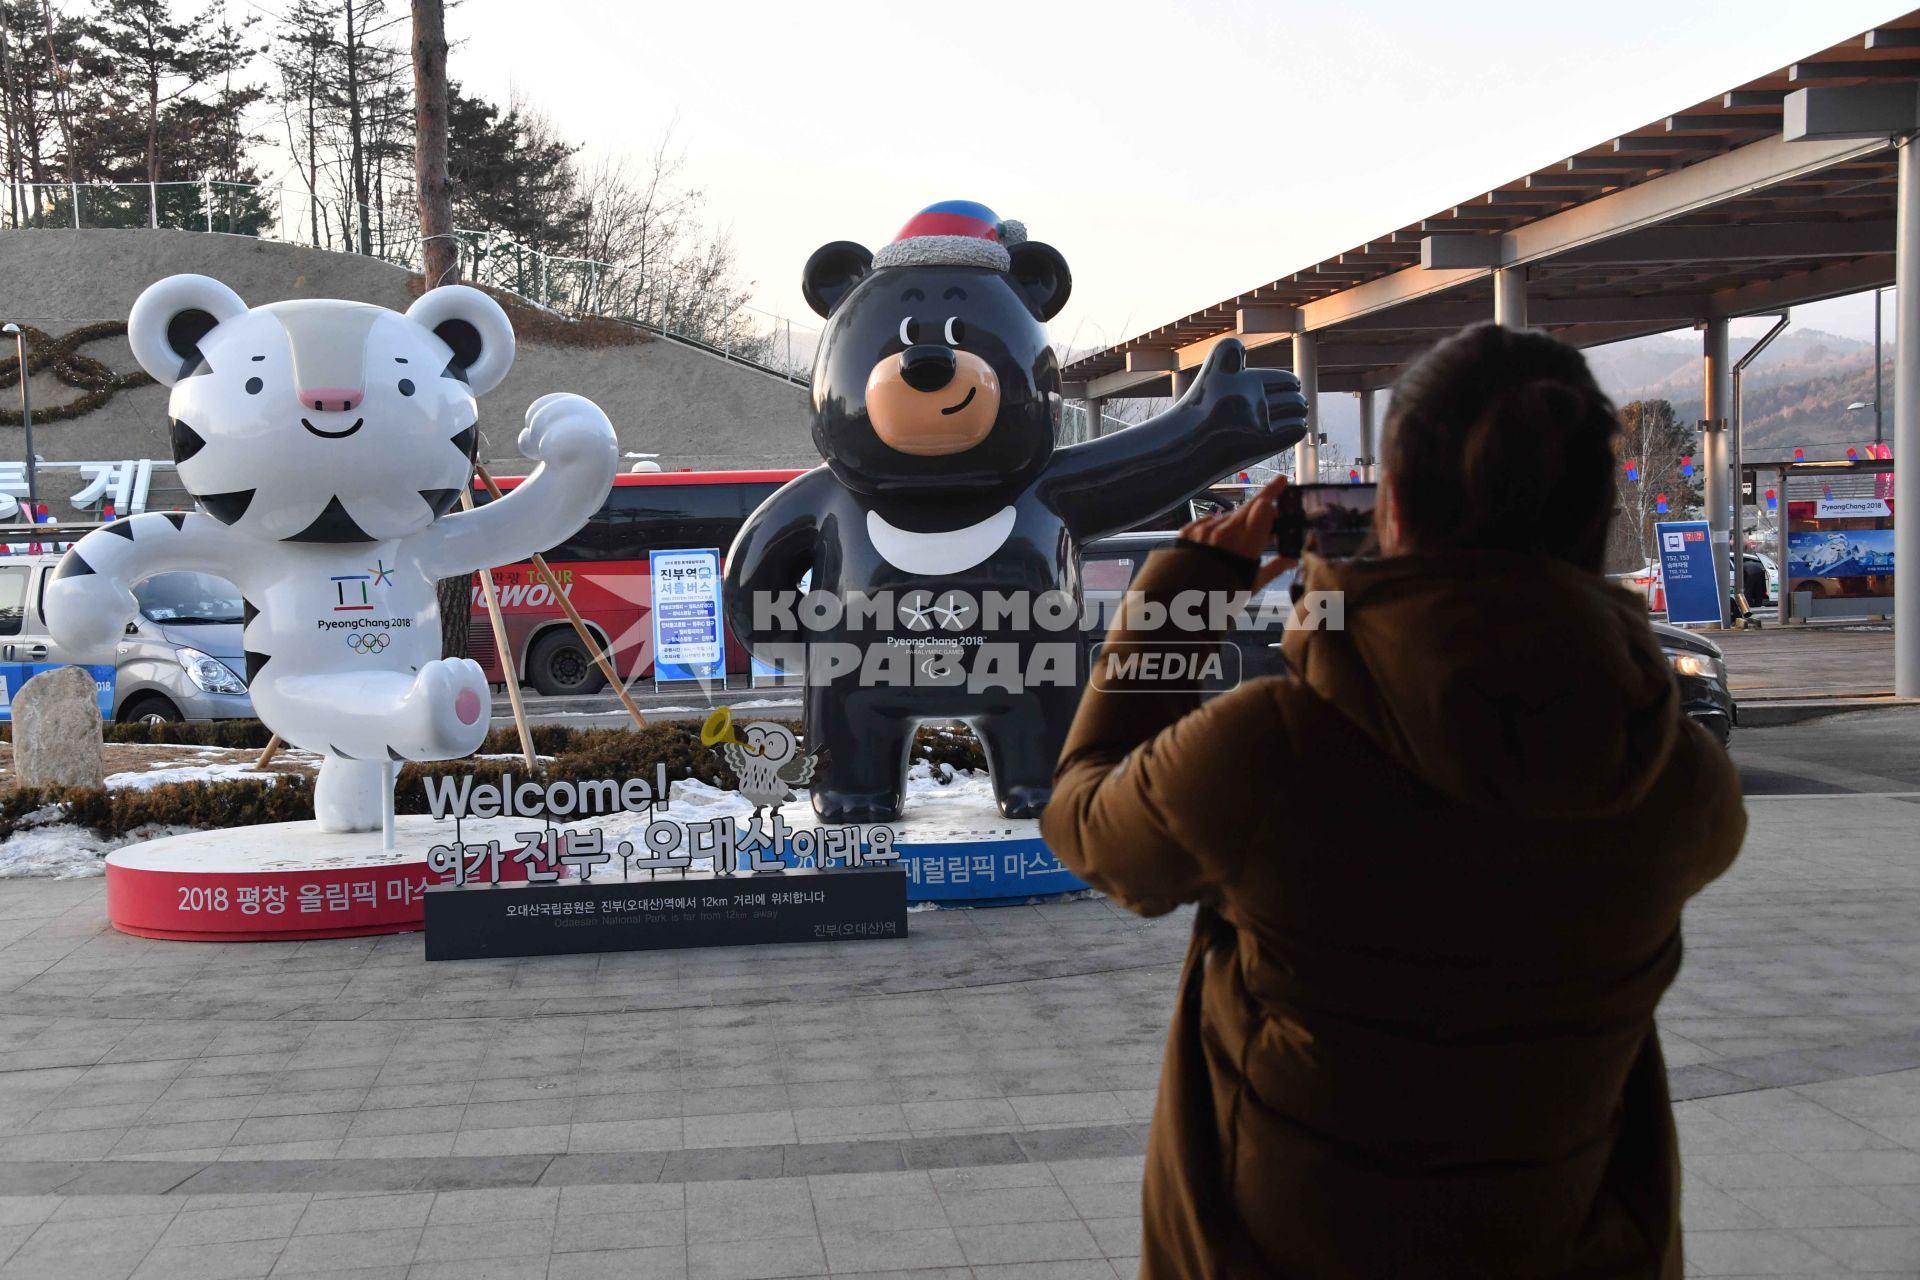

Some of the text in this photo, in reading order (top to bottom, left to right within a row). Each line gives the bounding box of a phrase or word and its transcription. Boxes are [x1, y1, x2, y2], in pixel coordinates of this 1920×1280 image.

[1821, 503, 1866, 511] PyeongChang
[660, 567, 698, 581] 진부역
[660, 582, 712, 595] 셔틀버스
[318, 618, 411, 631] PyeongChang 2018
[887, 636, 984, 648] PyeongChang 2018
[422, 762, 670, 821] Welcome!
[177, 886, 230, 912] 2018
[236, 885, 289, 915] 평창
[297, 880, 378, 914] 올림픽
[506, 891, 825, 917] 오대산국립공원은 진부(오대산)역에서 12km 거리에 위치합니다
[602, 914, 641, 925] National
[645, 914, 666, 923] Park
[813, 921, 897, 938] 진부(오대산)역
